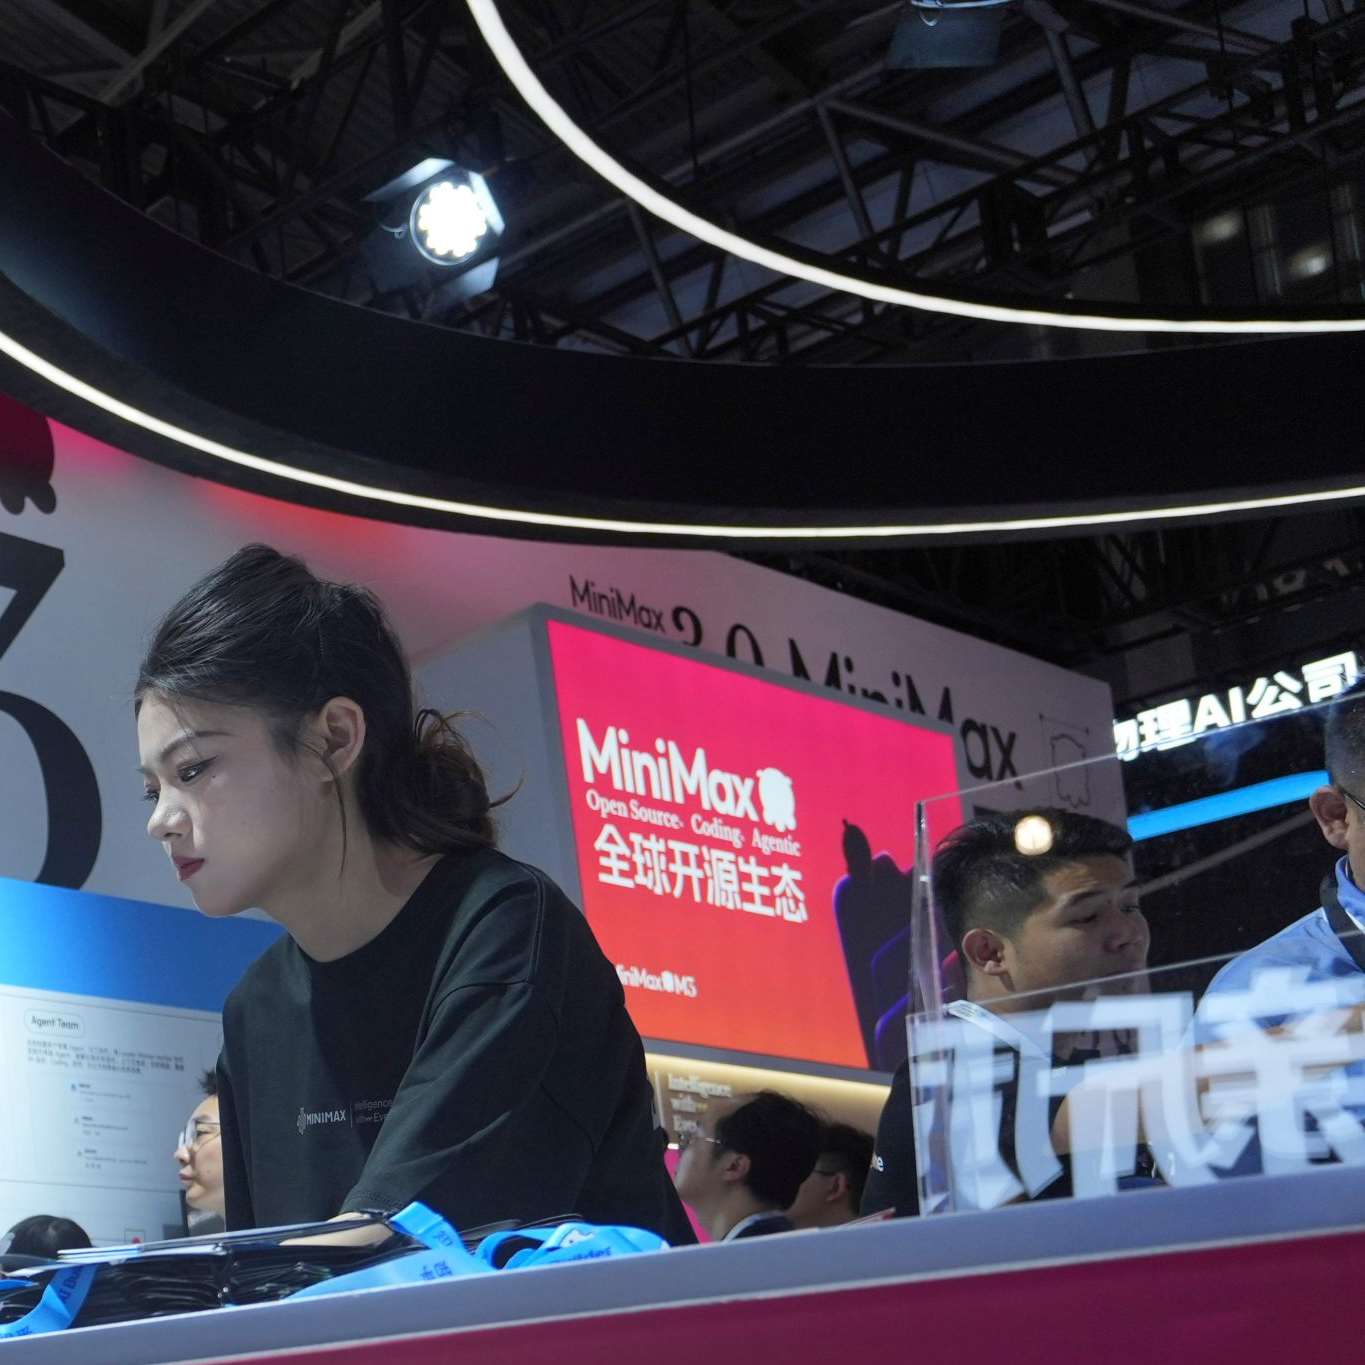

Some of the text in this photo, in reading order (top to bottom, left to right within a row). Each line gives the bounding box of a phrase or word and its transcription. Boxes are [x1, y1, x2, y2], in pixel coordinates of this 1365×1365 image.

[569, 574, 666, 633] MiniMax
[576, 718, 759, 822] MiniMax
[586, 789, 629, 819] Open
[752, 828, 802, 857] Agentic
[594, 823, 809, 923] 全球开源生态
[615, 963, 664, 992] iniMax
[31, 1015, 80, 1032] Agent Team
[307, 1109, 347, 1126] MINIMAX
